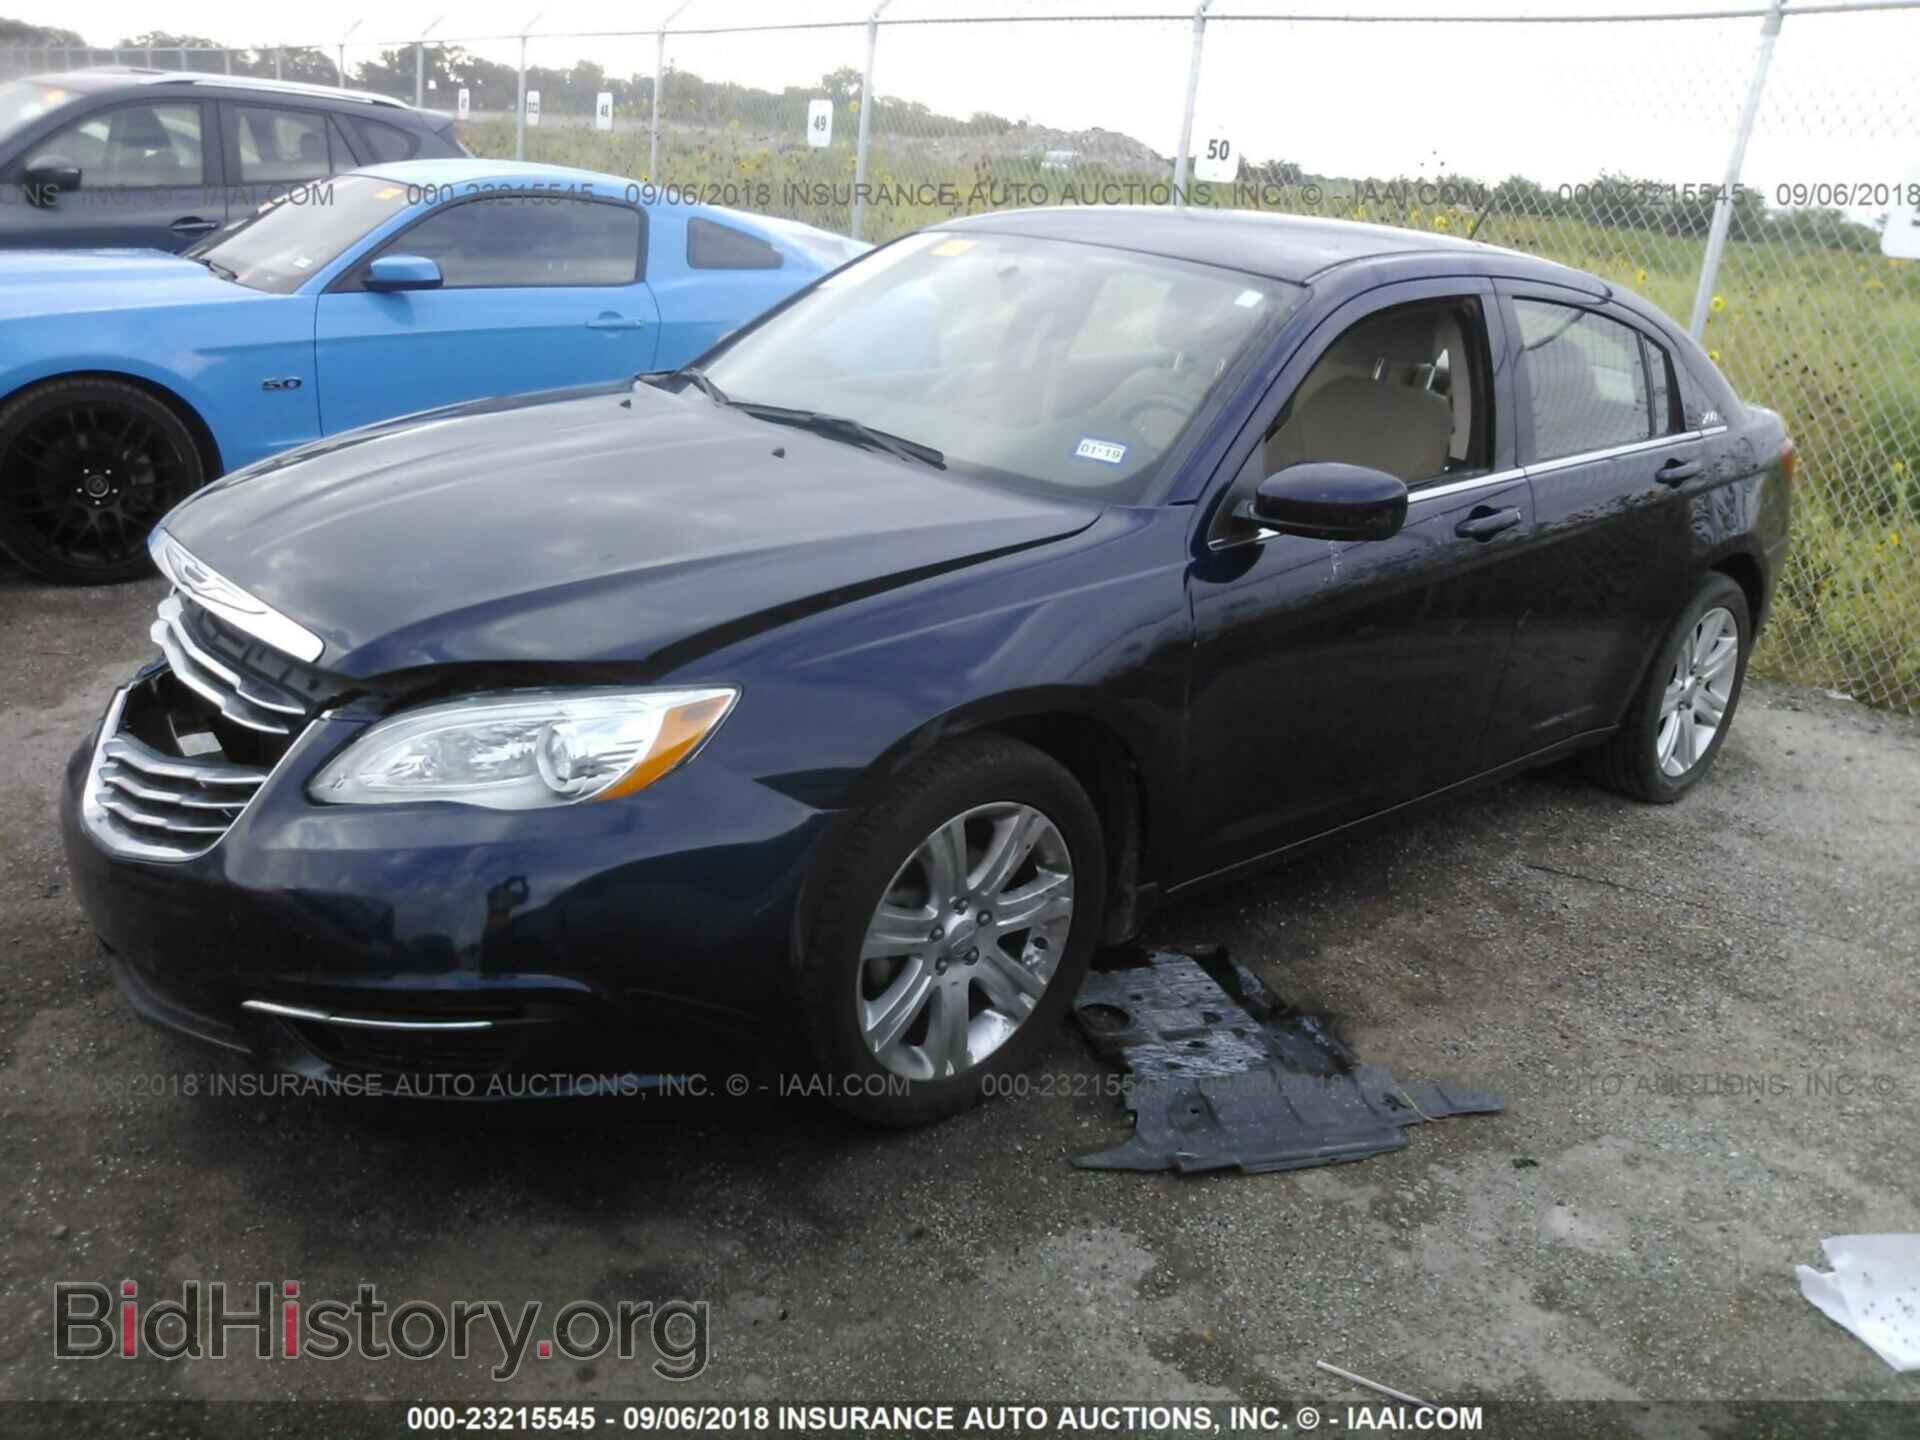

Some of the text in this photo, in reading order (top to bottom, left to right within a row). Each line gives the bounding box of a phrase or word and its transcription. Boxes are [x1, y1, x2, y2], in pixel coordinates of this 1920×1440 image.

[813, 114, 827, 132] 49
[1206, 138, 1230, 161] 50
[263, 379, 303, 391] 5.0
